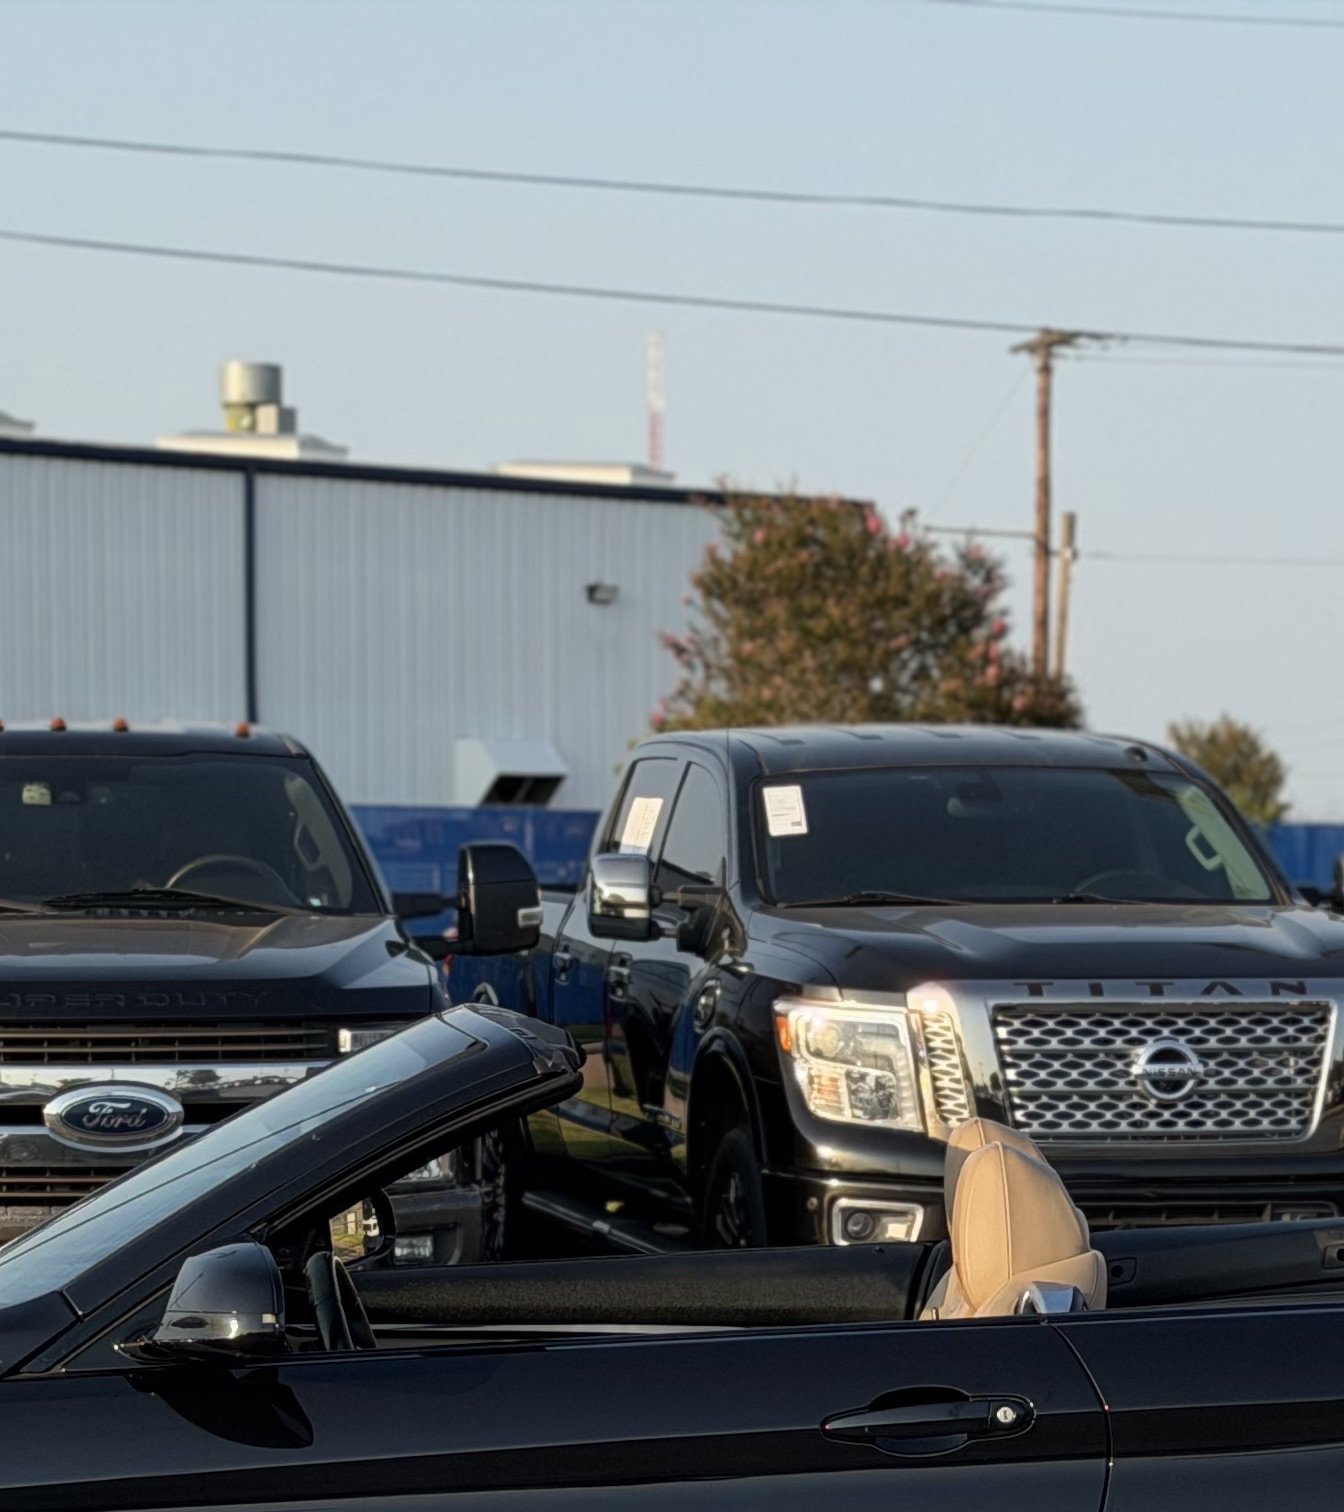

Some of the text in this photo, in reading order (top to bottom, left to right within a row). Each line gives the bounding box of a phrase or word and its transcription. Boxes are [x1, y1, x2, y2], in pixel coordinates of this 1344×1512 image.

[1011, 980, 1308, 998] TITAN
[1142, 1067, 1194, 1079] NISSAN
[82, 1101, 148, 1128] Ford
